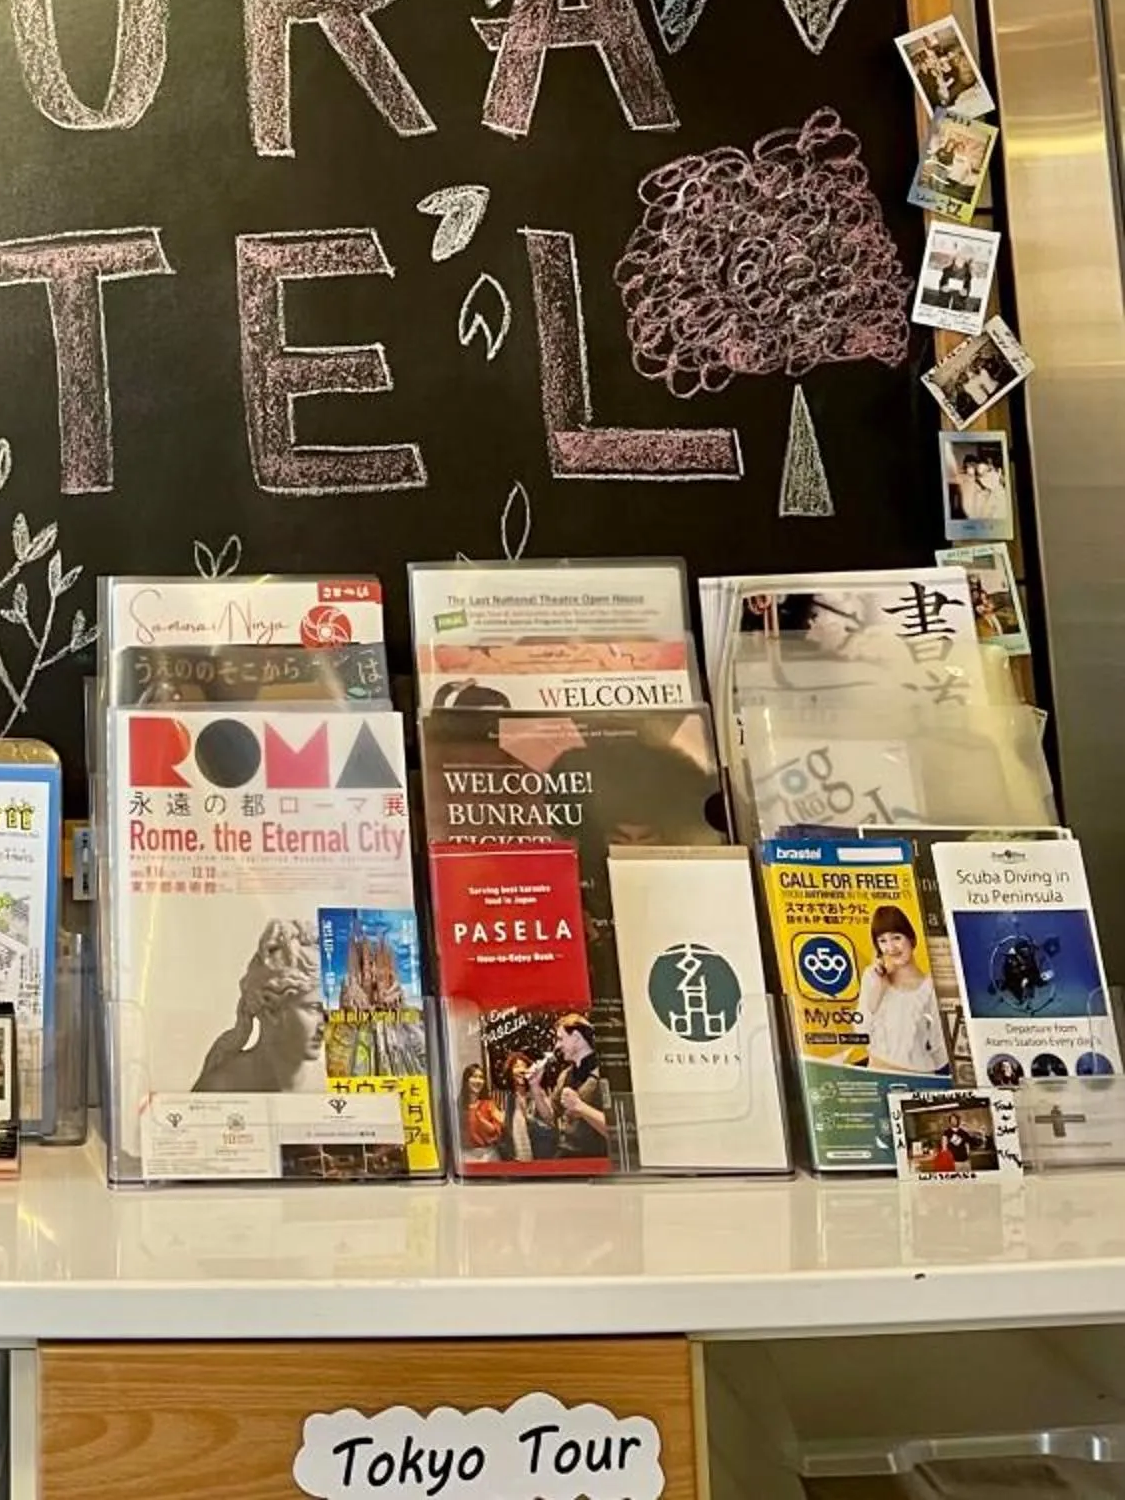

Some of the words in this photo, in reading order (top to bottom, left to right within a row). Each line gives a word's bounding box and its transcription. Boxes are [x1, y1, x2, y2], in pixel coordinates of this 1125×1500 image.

[538, 684, 684, 707] WELCOME!
[128, 717, 403, 789] ROMA
[443, 771, 594, 795] WELCOME!
[128, 792, 406, 817] 永遠の都ローマ展
[446, 802, 584, 826] BUNRAKU
[214, 822, 252, 851] the
[262, 821, 349, 852] Eternal
[359, 821, 405, 860] City
[780, 872, 819, 889] CALL
[822, 873, 852, 889] FOR
[855, 873, 898, 890] FREE!
[956, 869, 1001, 885] Scuba
[1004, 869, 1052, 887] Diving
[1056, 871, 1070, 883] in
[992, 889, 1064, 904] Peninsula
[454, 919, 572, 944] PASELA
[332, 1435, 485, 1497] Tokyo
[518, 1424, 642, 1475] Tour
